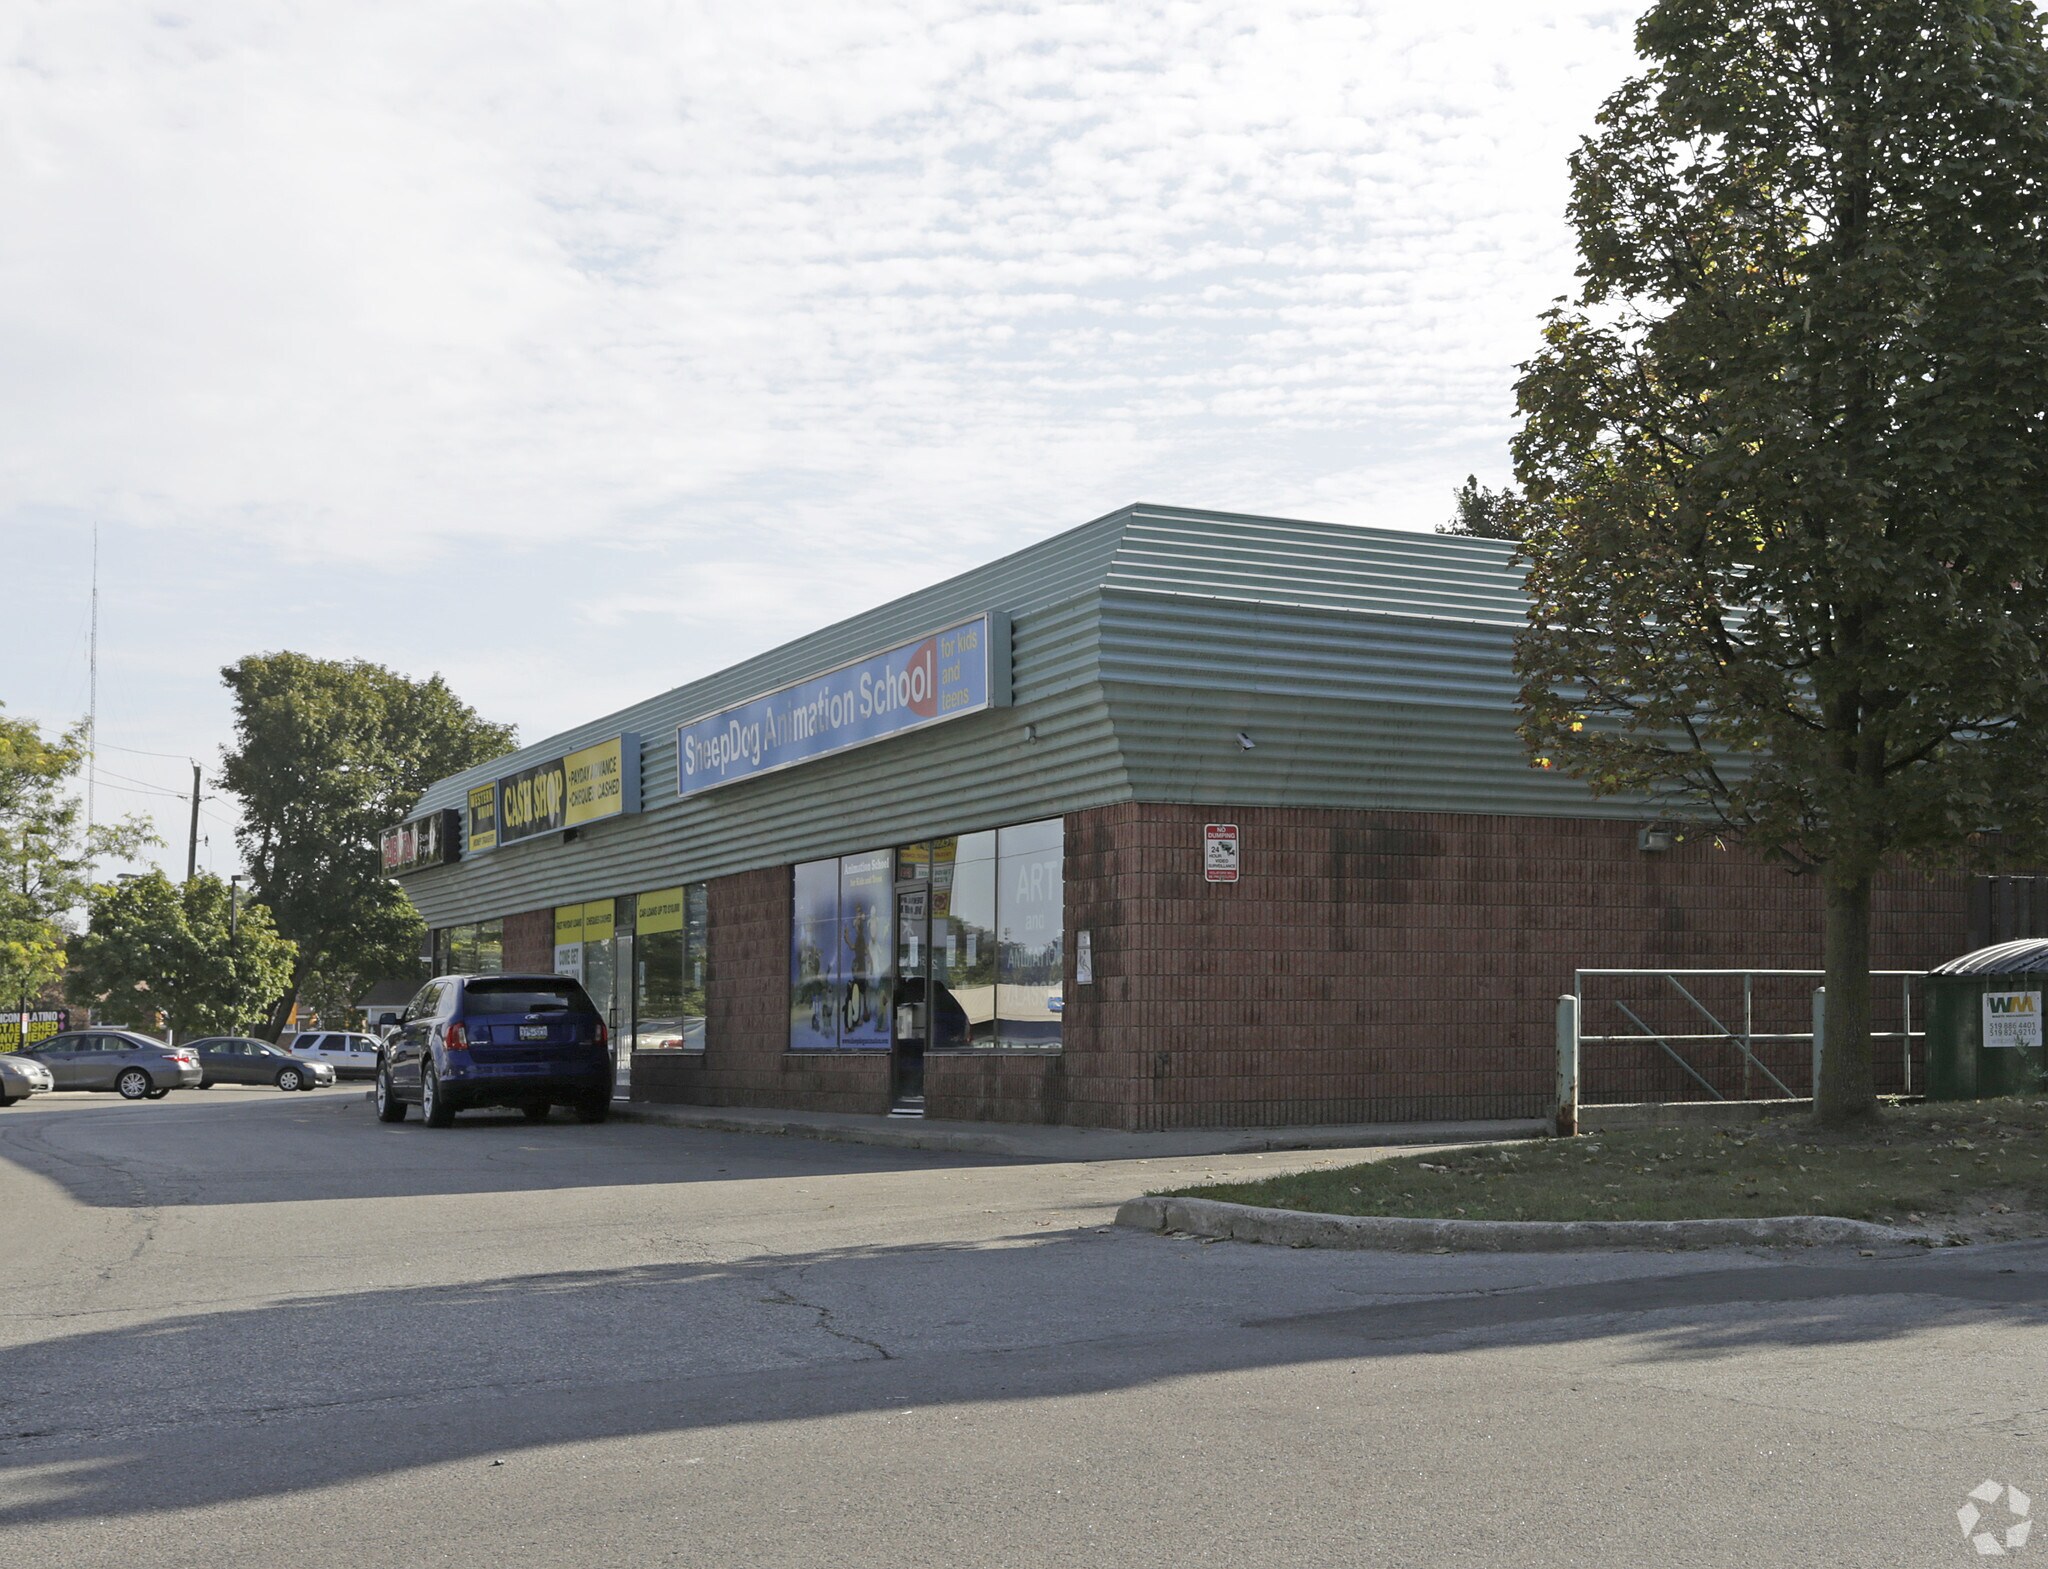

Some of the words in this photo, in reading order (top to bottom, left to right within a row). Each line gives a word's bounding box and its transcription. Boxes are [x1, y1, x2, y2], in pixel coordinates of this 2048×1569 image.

[942, 637, 956, 658] for
[958, 629, 978, 654] kids
[943, 661, 960, 685] and
[943, 688, 969, 710] teens
[686, 720, 760, 775] SheepDog
[764, 687, 854, 751] Animation
[861, 650, 931, 719] School
[1017, 861, 1058, 904] ART
[1026, 911, 1044, 930] and
[28, 1011, 58, 1022] LATINO
[1989, 996, 2034, 1014] WM
